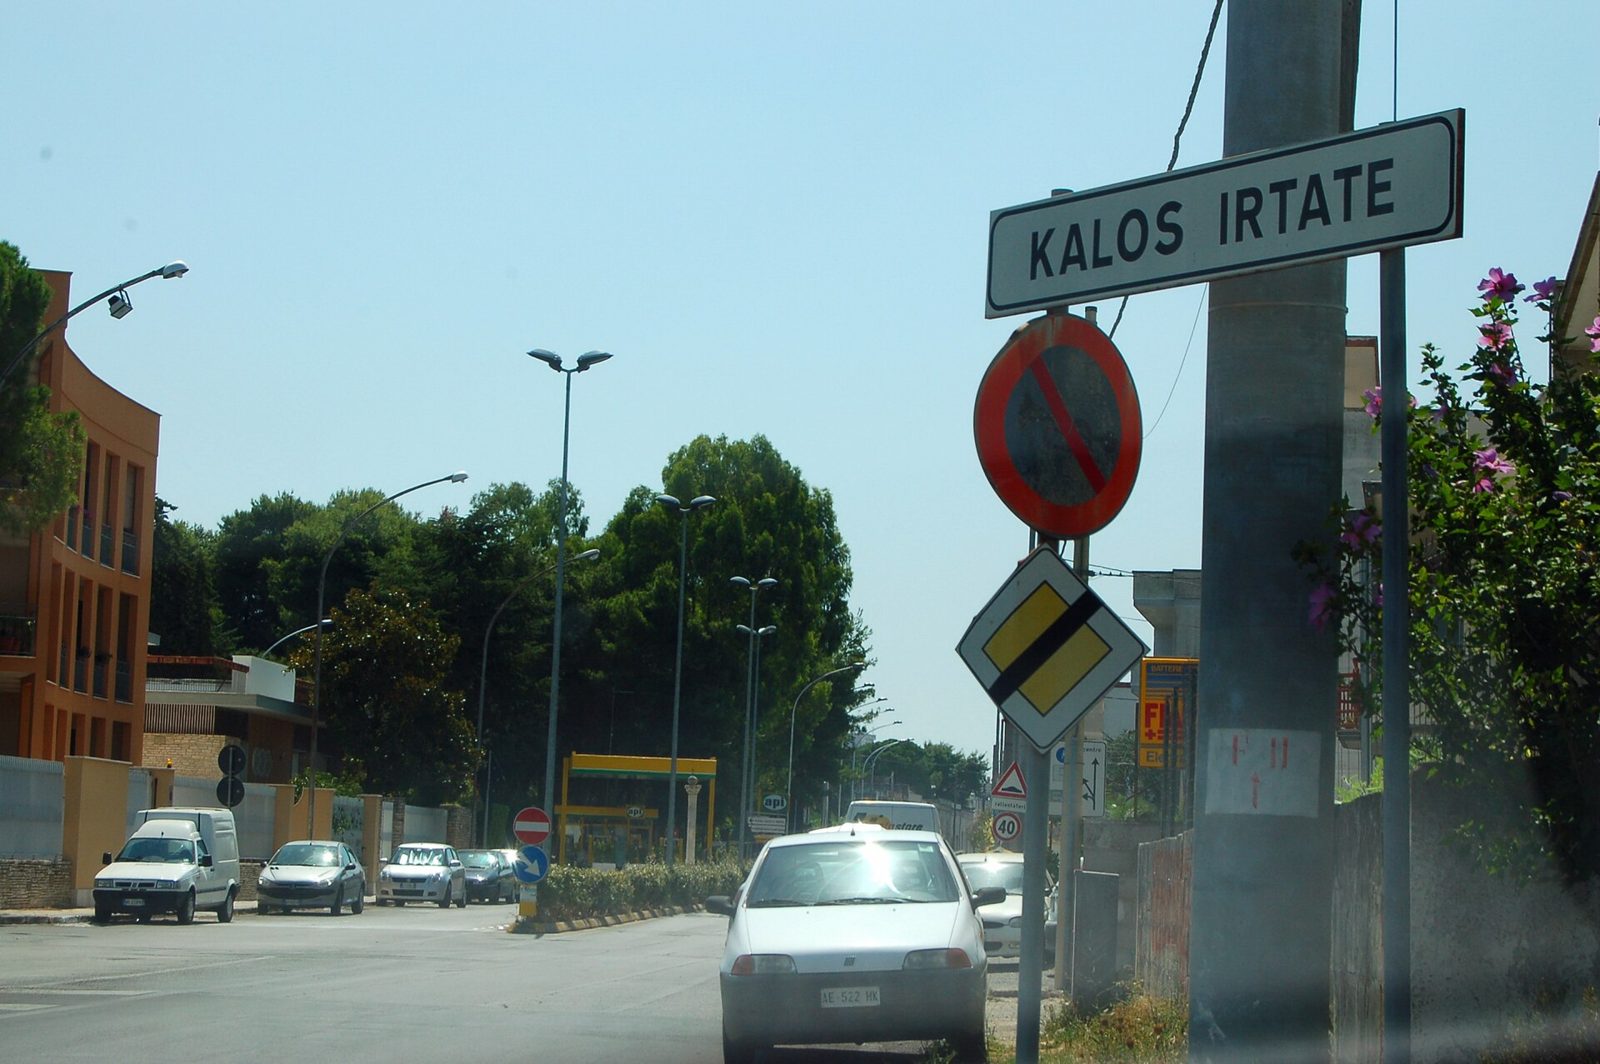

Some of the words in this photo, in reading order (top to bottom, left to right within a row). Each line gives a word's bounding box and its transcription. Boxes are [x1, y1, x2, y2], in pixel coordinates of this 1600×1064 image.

[1029, 201, 1184, 281] KALOS
[1219, 158, 1395, 246] IRTATE
[764, 797, 784, 809] api
[997, 820, 1016, 835] 40
[841, 990, 861, 1002] 522
